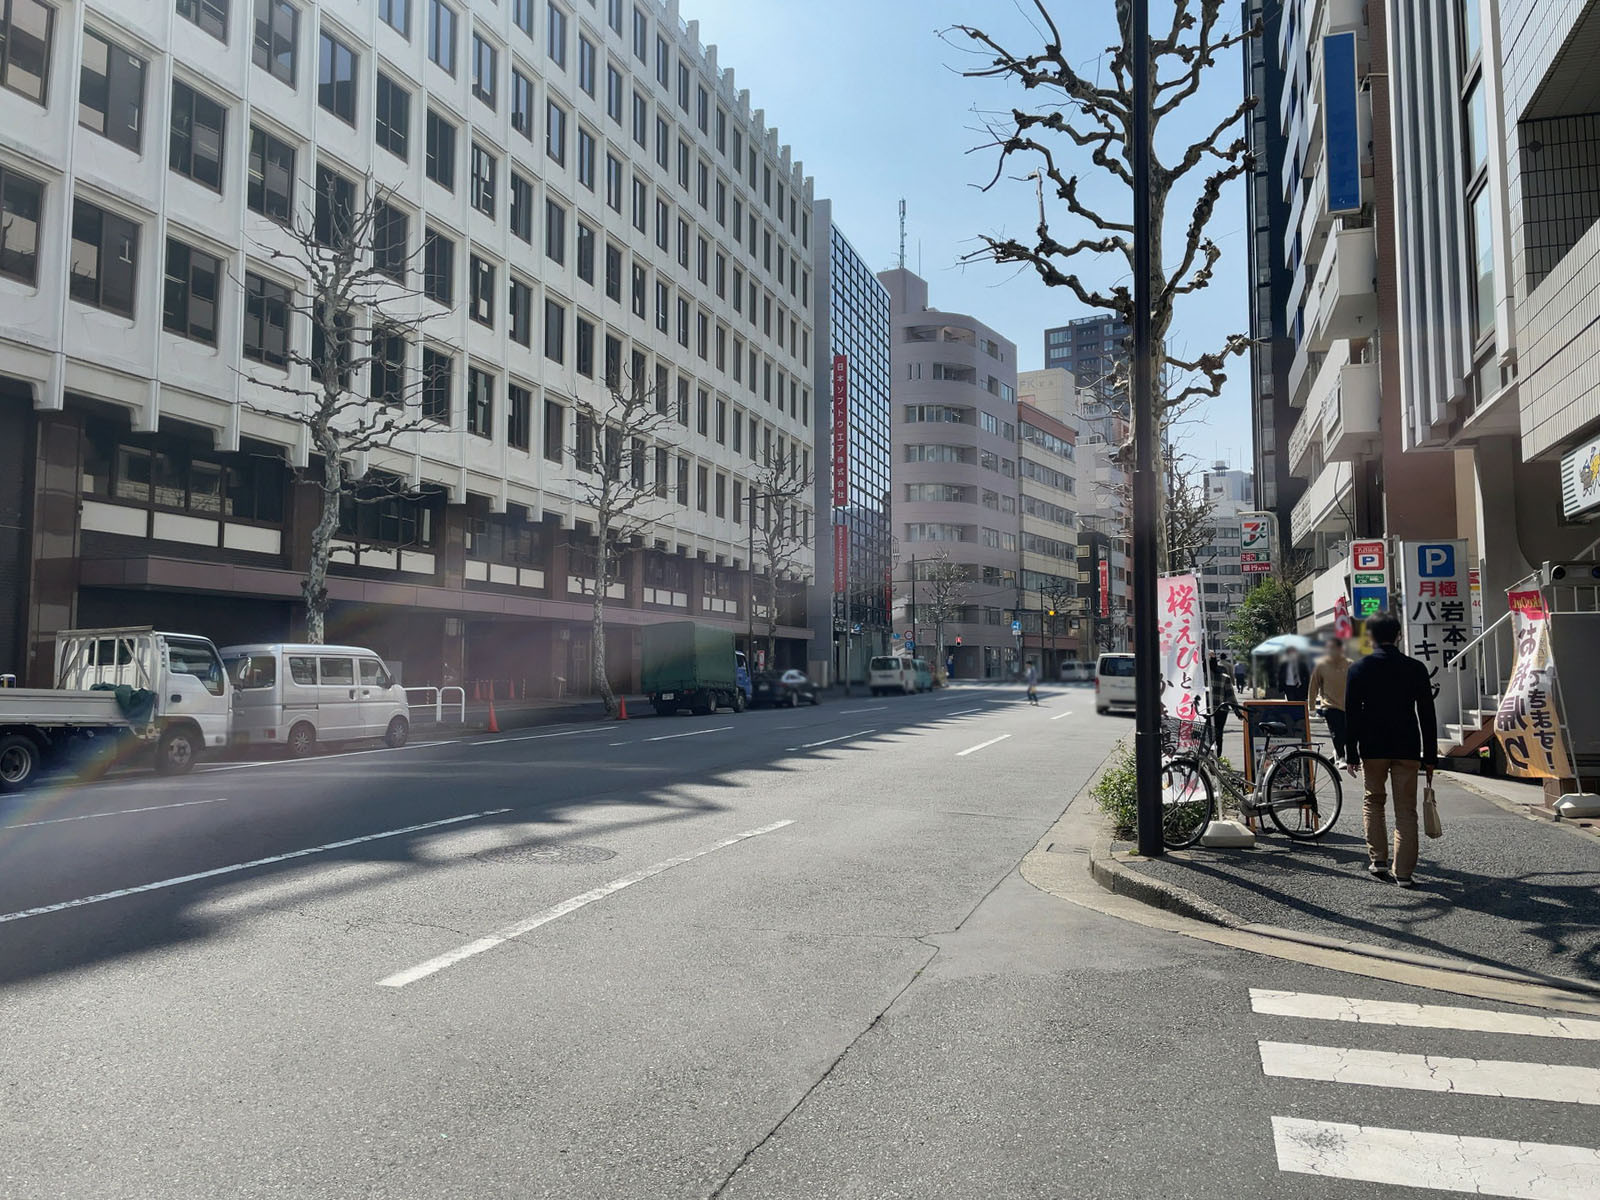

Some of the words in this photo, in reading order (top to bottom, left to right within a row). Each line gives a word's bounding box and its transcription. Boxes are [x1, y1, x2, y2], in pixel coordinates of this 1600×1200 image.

[1362, 556, 1375, 565] P
[1425, 548, 1447, 574] P
[1418, 581, 1458, 597] 月極
[1360, 597, 1380, 616] 空
[1440, 601, 1467, 671] 岩本町
